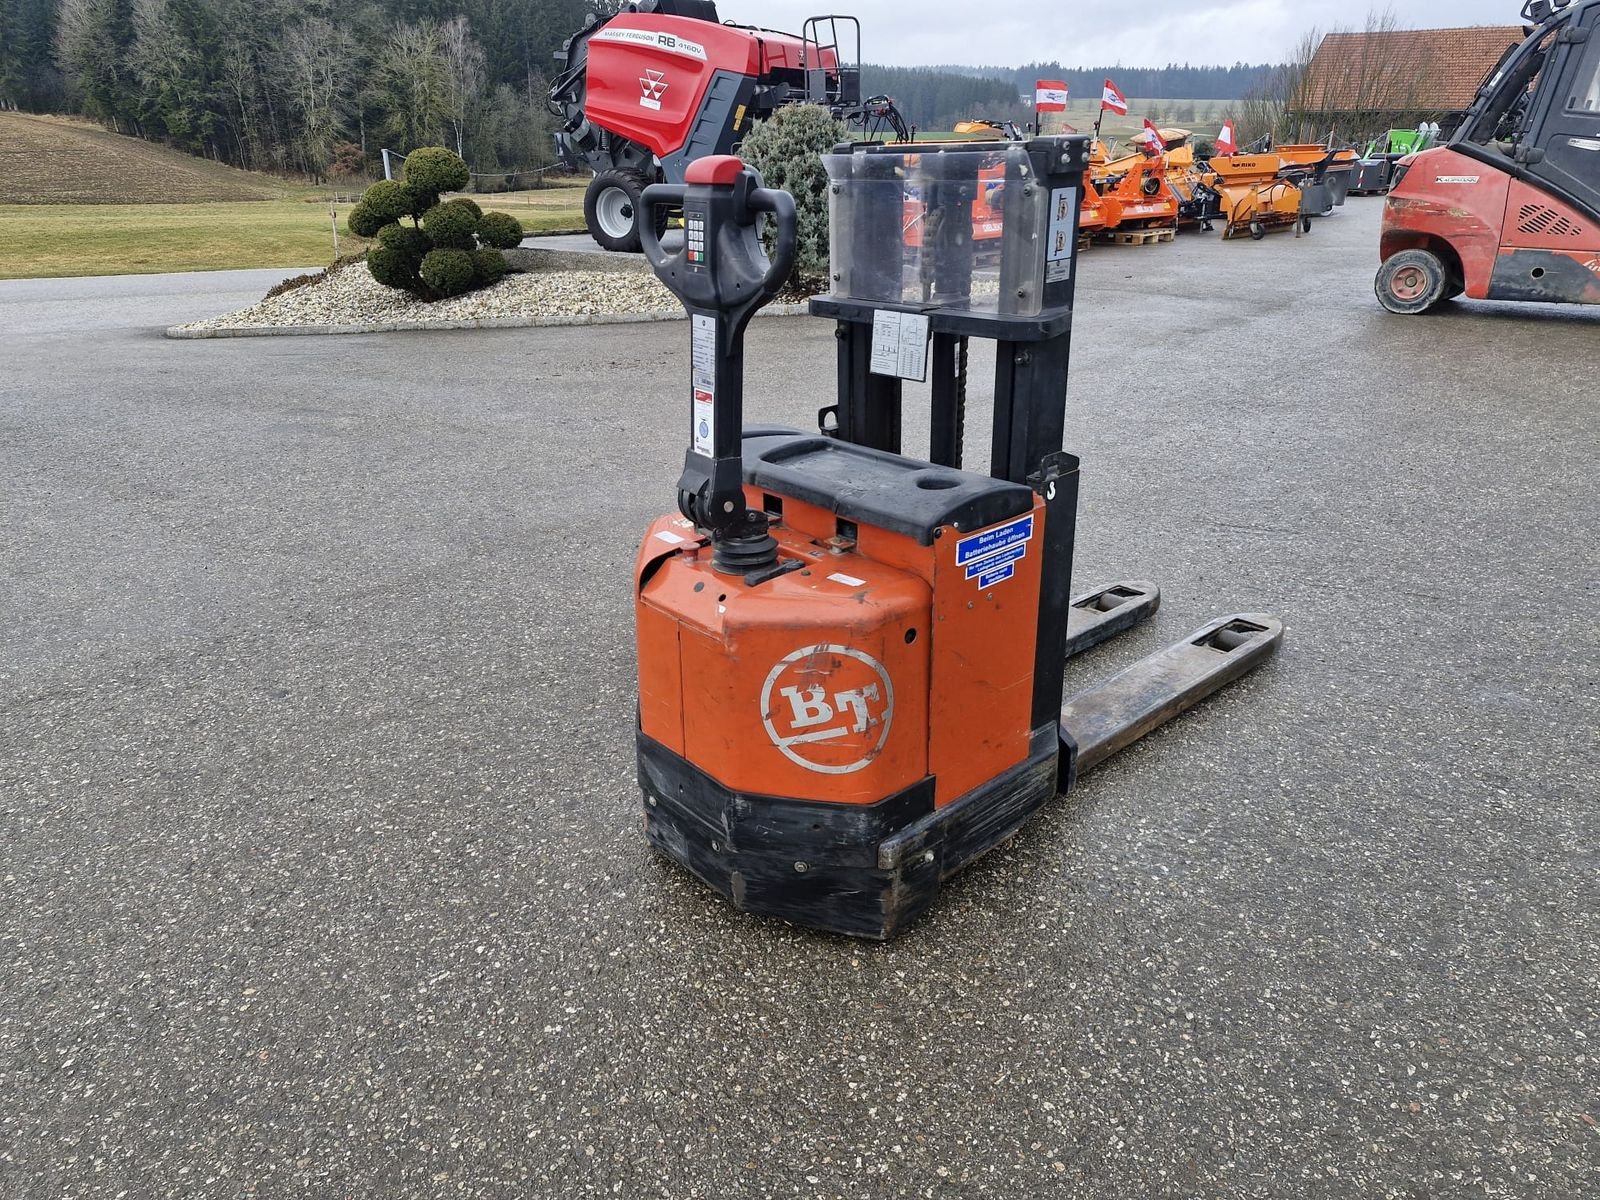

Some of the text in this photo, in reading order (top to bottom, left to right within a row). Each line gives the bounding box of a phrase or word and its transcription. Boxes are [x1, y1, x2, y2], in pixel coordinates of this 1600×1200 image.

[625, 32, 655, 42] FERGUSON
[658, 35, 675, 48] RB
[678, 43, 702, 53] 4160V
[964, 539, 1006, 559] Batteriehaube
[1007, 532, 1026, 543] öffnen
[978, 527, 1014, 544] Beim Laden
[780, 683, 880, 733] BT
